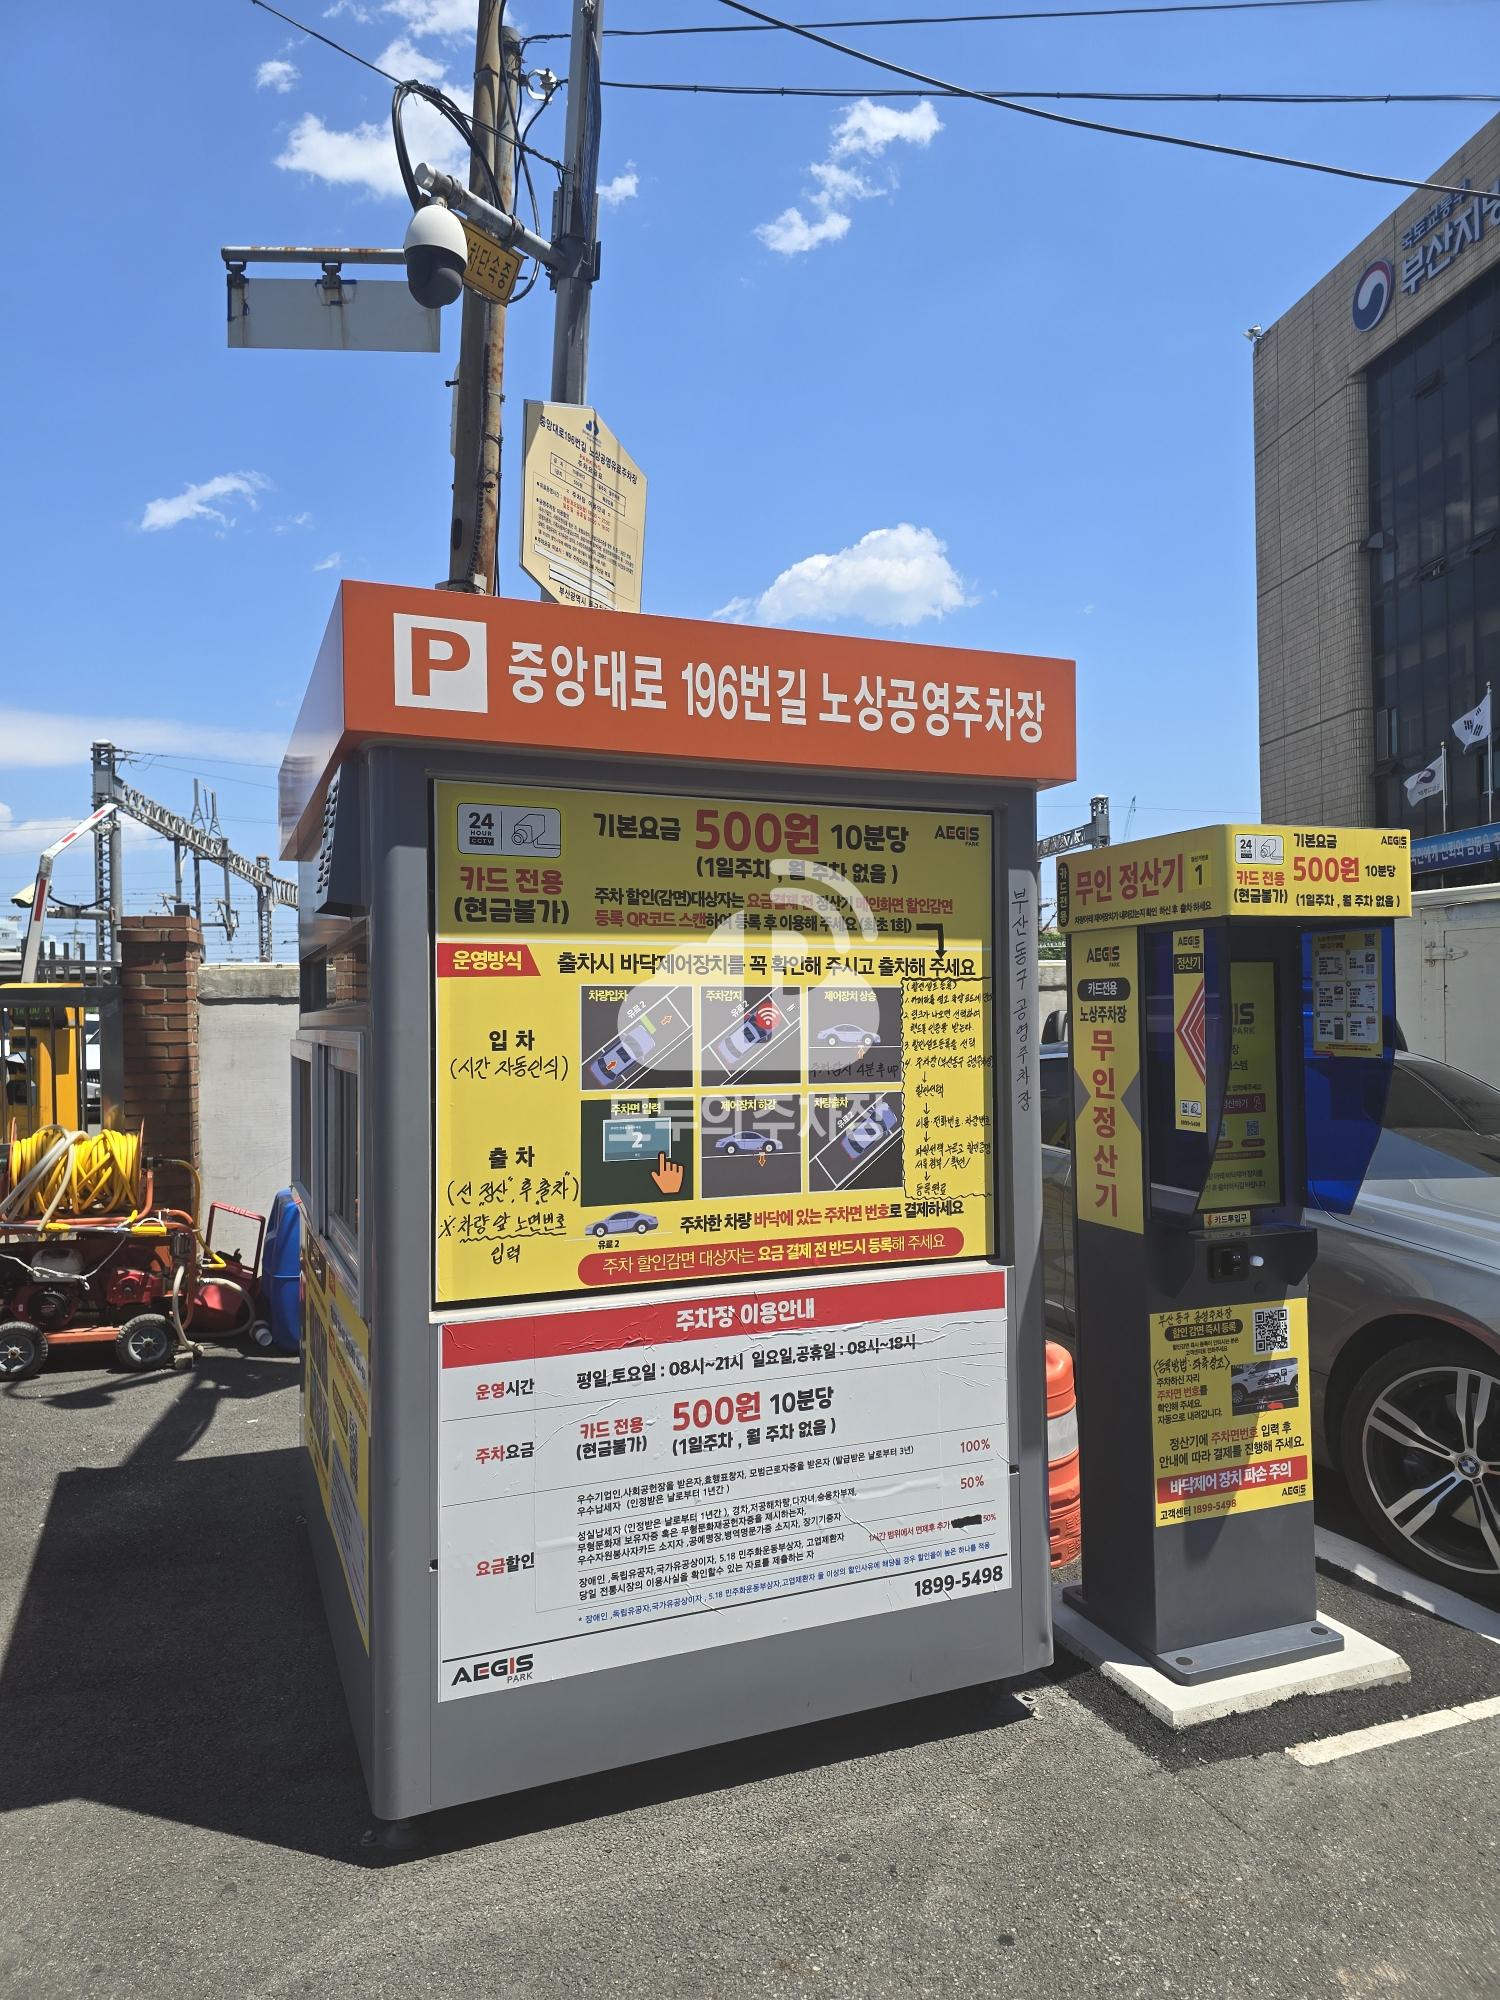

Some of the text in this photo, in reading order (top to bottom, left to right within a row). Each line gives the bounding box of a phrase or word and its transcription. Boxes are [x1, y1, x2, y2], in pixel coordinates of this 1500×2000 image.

[411, 626, 470, 697] P
[508, 641, 1045, 744] 중앙대로 196번길 노상공영주차장
[468, 812, 494, 830] 24
[593, 809, 909, 855] 기본요금 500원 10분당
[470, 837, 494, 846] CCTV
[934, 825, 980, 840] AEGIS
[1293, 833, 1338, 849] 기본요금
[1381, 836, 1407, 846] AEGIS
[1240, 839, 1252, 849] 24
[460, 867, 564, 895] 카드 전용
[812, 862, 887, 884] 주차 없음
[1075, 853, 1184, 906] 무인 정산기
[1194, 864, 1203, 885] 1
[1236, 856, 1396, 886] 카드 전용 500원 10분당
[595, 888, 953, 914] 주차 할인감면
[1233, 888, 1373, 908] (현금불가) (1일주차 주차
[454, 897, 570, 925] (현금불가)
[595, 910, 858, 932] 등록 QR코드 등록 후 이용해 주세요
[1177, 935, 1200, 947] AEGIS
[453, 950, 522, 971] 운영방식
[557, 952, 977, 977] 출차시 바닥제어장치를 꼭 확인해 주시고 출차해 주세요
[1087, 945, 1120, 963] AEGIS
[1177, 955, 1201, 970] 정산기
[588, 990, 628, 1002] 차량입차
[706, 991, 742, 1003] 주차감지
[1087, 981, 1118, 996] 카드전용
[1080, 1005, 1127, 1024] 노상주차장
[611, 1103, 640, 1115] 주차면
[680, 1200, 964, 1234] 주차한 차량 바닥에 있는 주차면 번호로 결제하세요
[1214, 1213, 1247, 1224] 카드투입구
[602, 1233, 945, 1275] 주차 할인감면 대상자는 요금 결제 전 반드시 등록해 주세요
[676, 1298, 815, 1331] 주차장 이용안내
[475, 1334, 916, 1400] 운영시간 평일,토요일 08시~21시 일요일,공휴일 08시~18시
[1157, 1373, 1200, 1387] 주차하신 자리
[1157, 1385, 1208, 1401] 주차면 번호를
[1157, 1402, 1179, 1413] 확인해
[1157, 1412, 1186, 1425] 자동으로
[475, 1386, 834, 1465] 주차요금 카드 전용 500원 10분당
[1169, 1421, 1292, 1451] 정산기에 주차면번호 입력 후
[576, 1419, 827, 1460] (현금불가) (1일주차 월 주차 없음
[960, 1438, 991, 1453] 100%
[807, 1448, 898, 1468] 받은자 날로부터
[1159, 1435, 1305, 1469] 안내에 따라 결제를 진행해 주세요.
[960, 1475, 985, 1490] 50%
[1170, 1460, 1292, 1496] 바닥제어 장치 파손 주의
[1282, 1485, 1306, 1497] AEGIS
[577, 1488, 701, 1517] 우수납세자 날로부터
[1160, 1499, 1237, 1521] 고객센터 1899-5498
[577, 1512, 698, 1541] 성실납세자 날로부터
[803, 1513, 842, 1527] 장기기증자
[577, 1528, 678, 1554] 무형문화재 혹은
[719, 1532, 845, 1563] 5.18 고엽제환자
[475, 1552, 535, 1577] 요금할인
[579, 1551, 803, 1601] 당일 전통시장의 이용사실을 있는 자료를 제출하는
[914, 1565, 1003, 1597] 1899-5498
[451, 1653, 533, 1686] AEGIS
[507, 1672, 533, 1684] PARK
